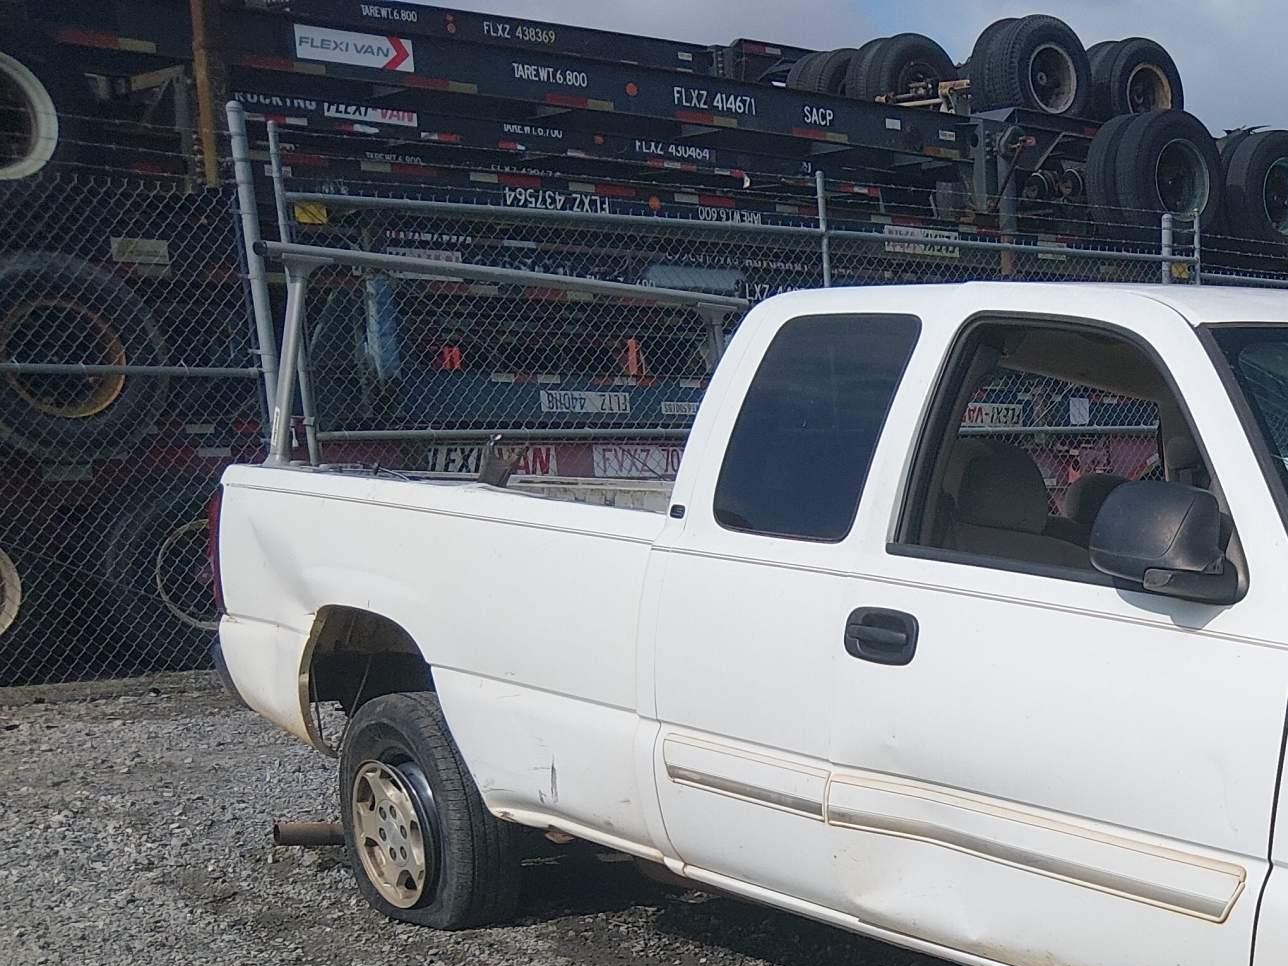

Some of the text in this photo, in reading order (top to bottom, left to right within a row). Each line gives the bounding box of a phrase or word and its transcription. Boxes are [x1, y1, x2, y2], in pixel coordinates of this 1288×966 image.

[483, 21, 556, 43] FLXZ 438369
[298, 36, 390, 58] FLEXI VAN
[673, 86, 756, 116] FLXZ 414671
[803, 105, 835, 127] SACP
[503, 186, 610, 214] FLXZ 437564
[602, 447, 685, 474] FVXZ 70
